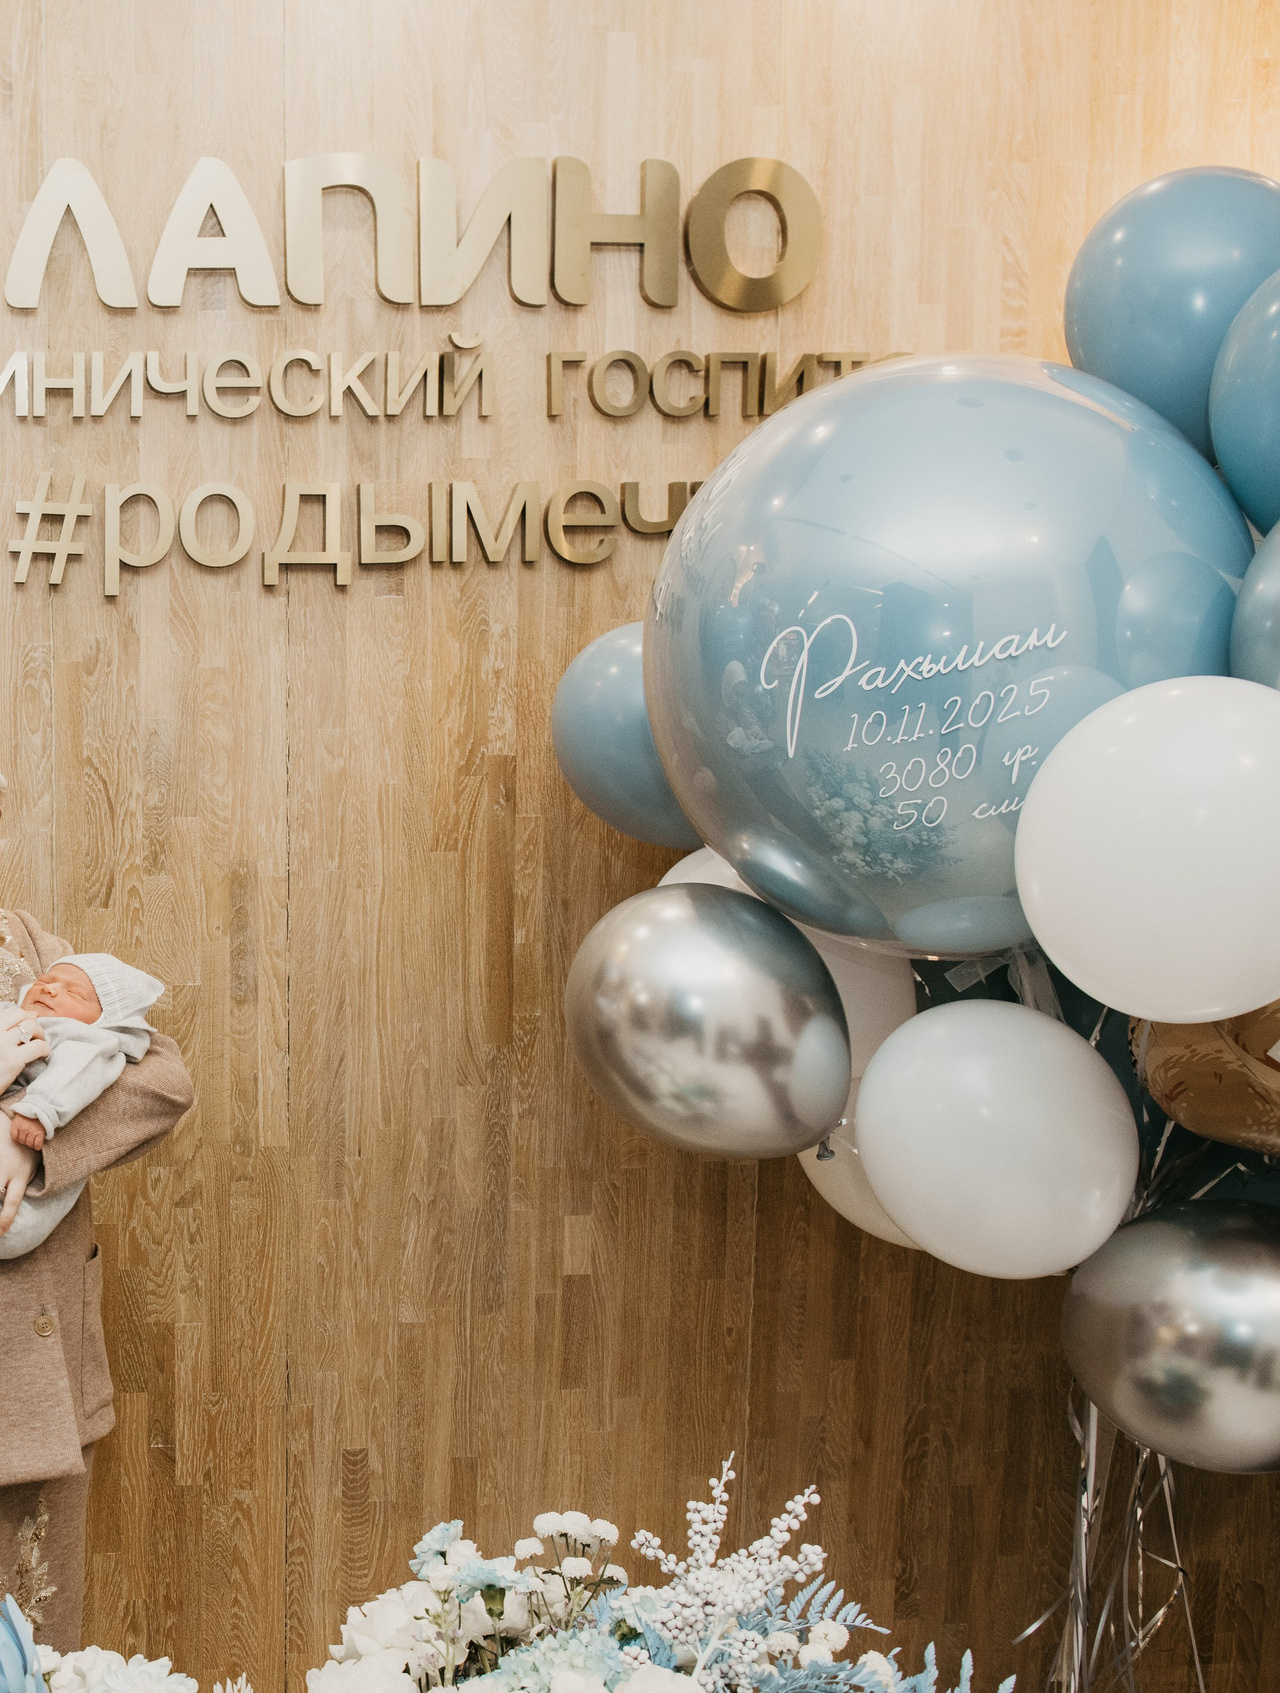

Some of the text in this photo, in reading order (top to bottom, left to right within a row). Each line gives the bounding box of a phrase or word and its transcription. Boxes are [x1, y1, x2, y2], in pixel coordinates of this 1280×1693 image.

[4, 152, 824, 312] ЛАПИНО
[546, 349, 918, 418] госпит
[7, 471, 706, 597] #родымеч
[843, 675, 1055, 752] 10.11.2025
[878, 743, 977, 798] 3080
[892, 796, 948, 830] 50
